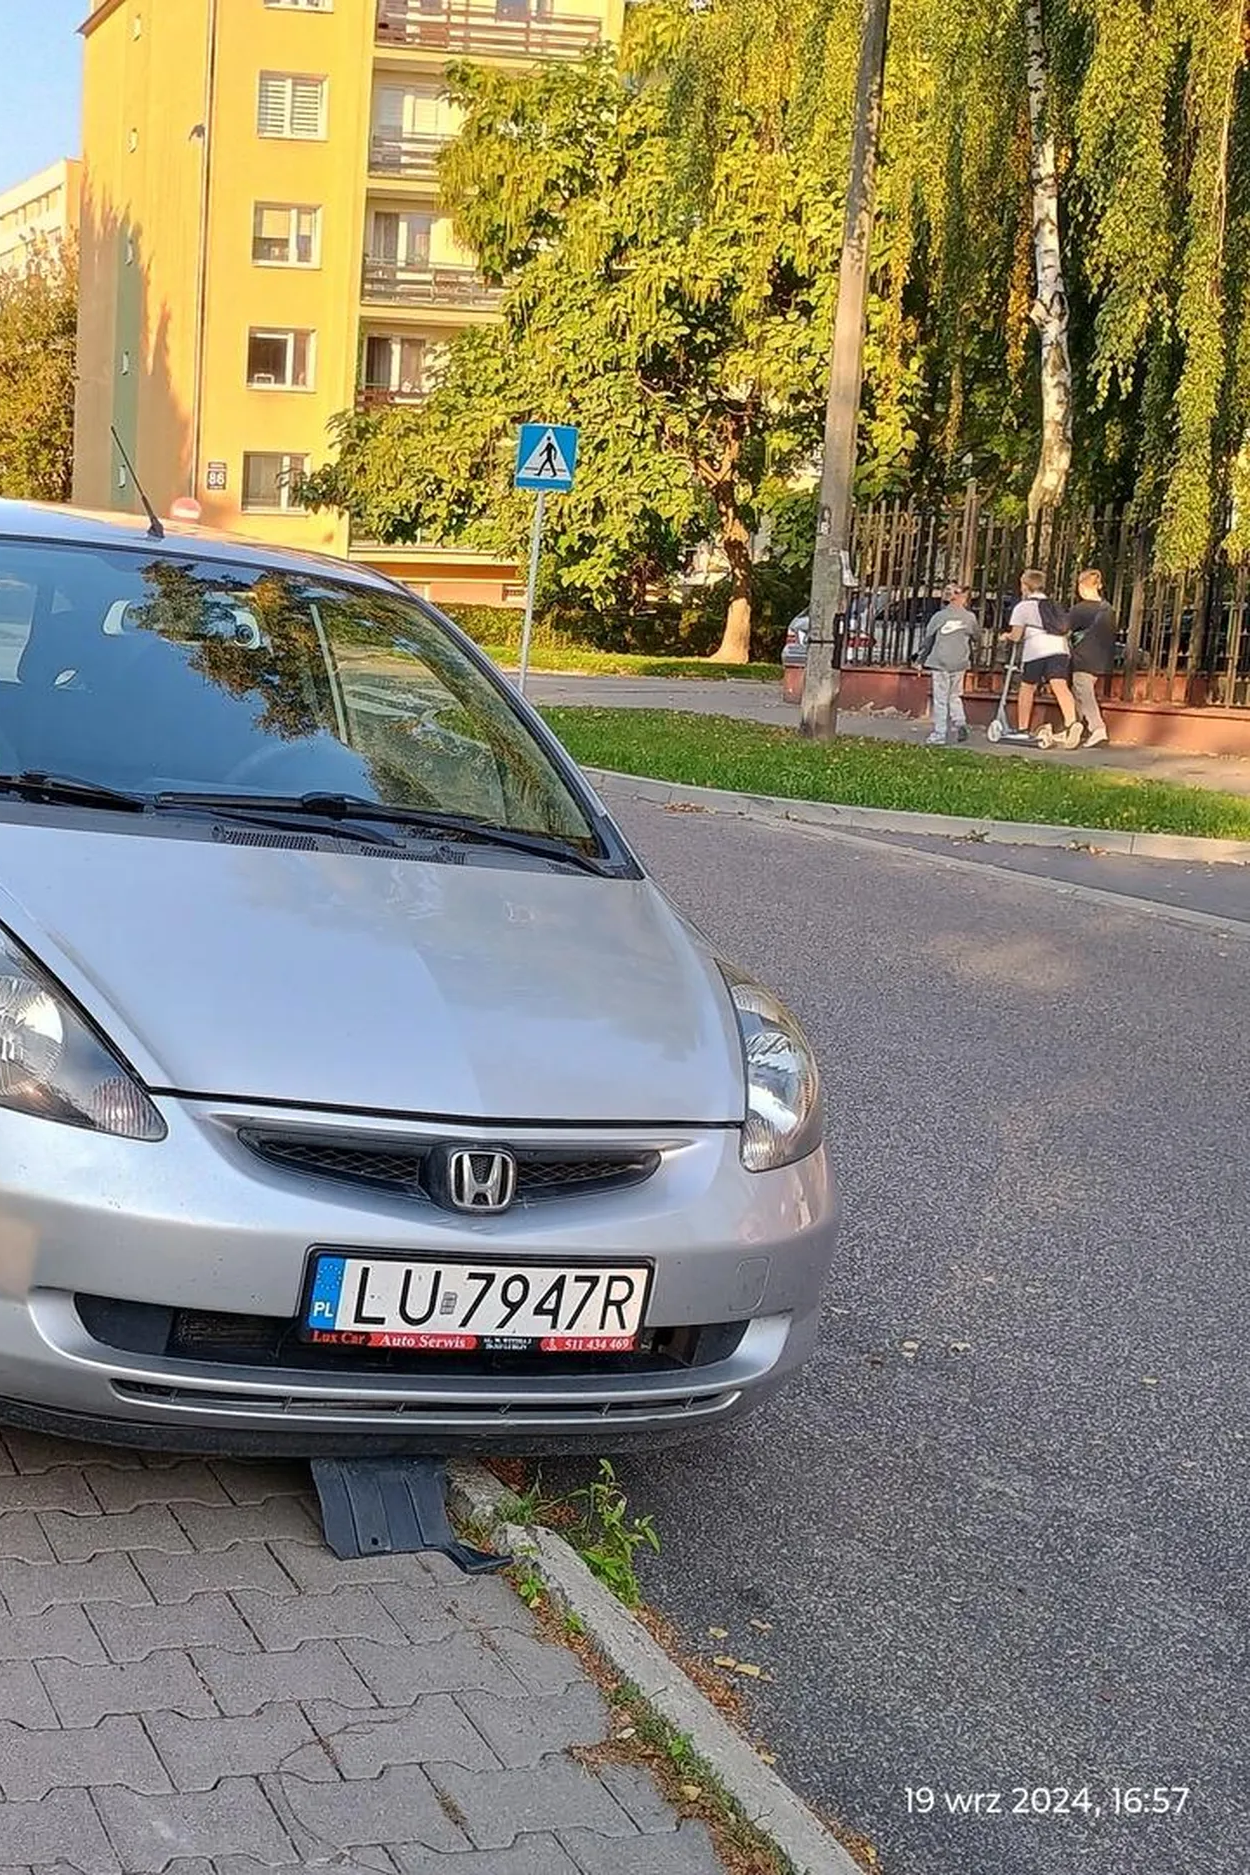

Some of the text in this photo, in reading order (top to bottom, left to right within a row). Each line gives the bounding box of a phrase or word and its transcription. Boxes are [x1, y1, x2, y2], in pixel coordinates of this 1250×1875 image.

[353, 1266, 635, 1331] LU 7947R
[313, 1301, 334, 1318] PL
[312, 1330, 466, 1349] Lux Car Auto Serwis
[564, 1338, 630, 1350] 511 434 469
